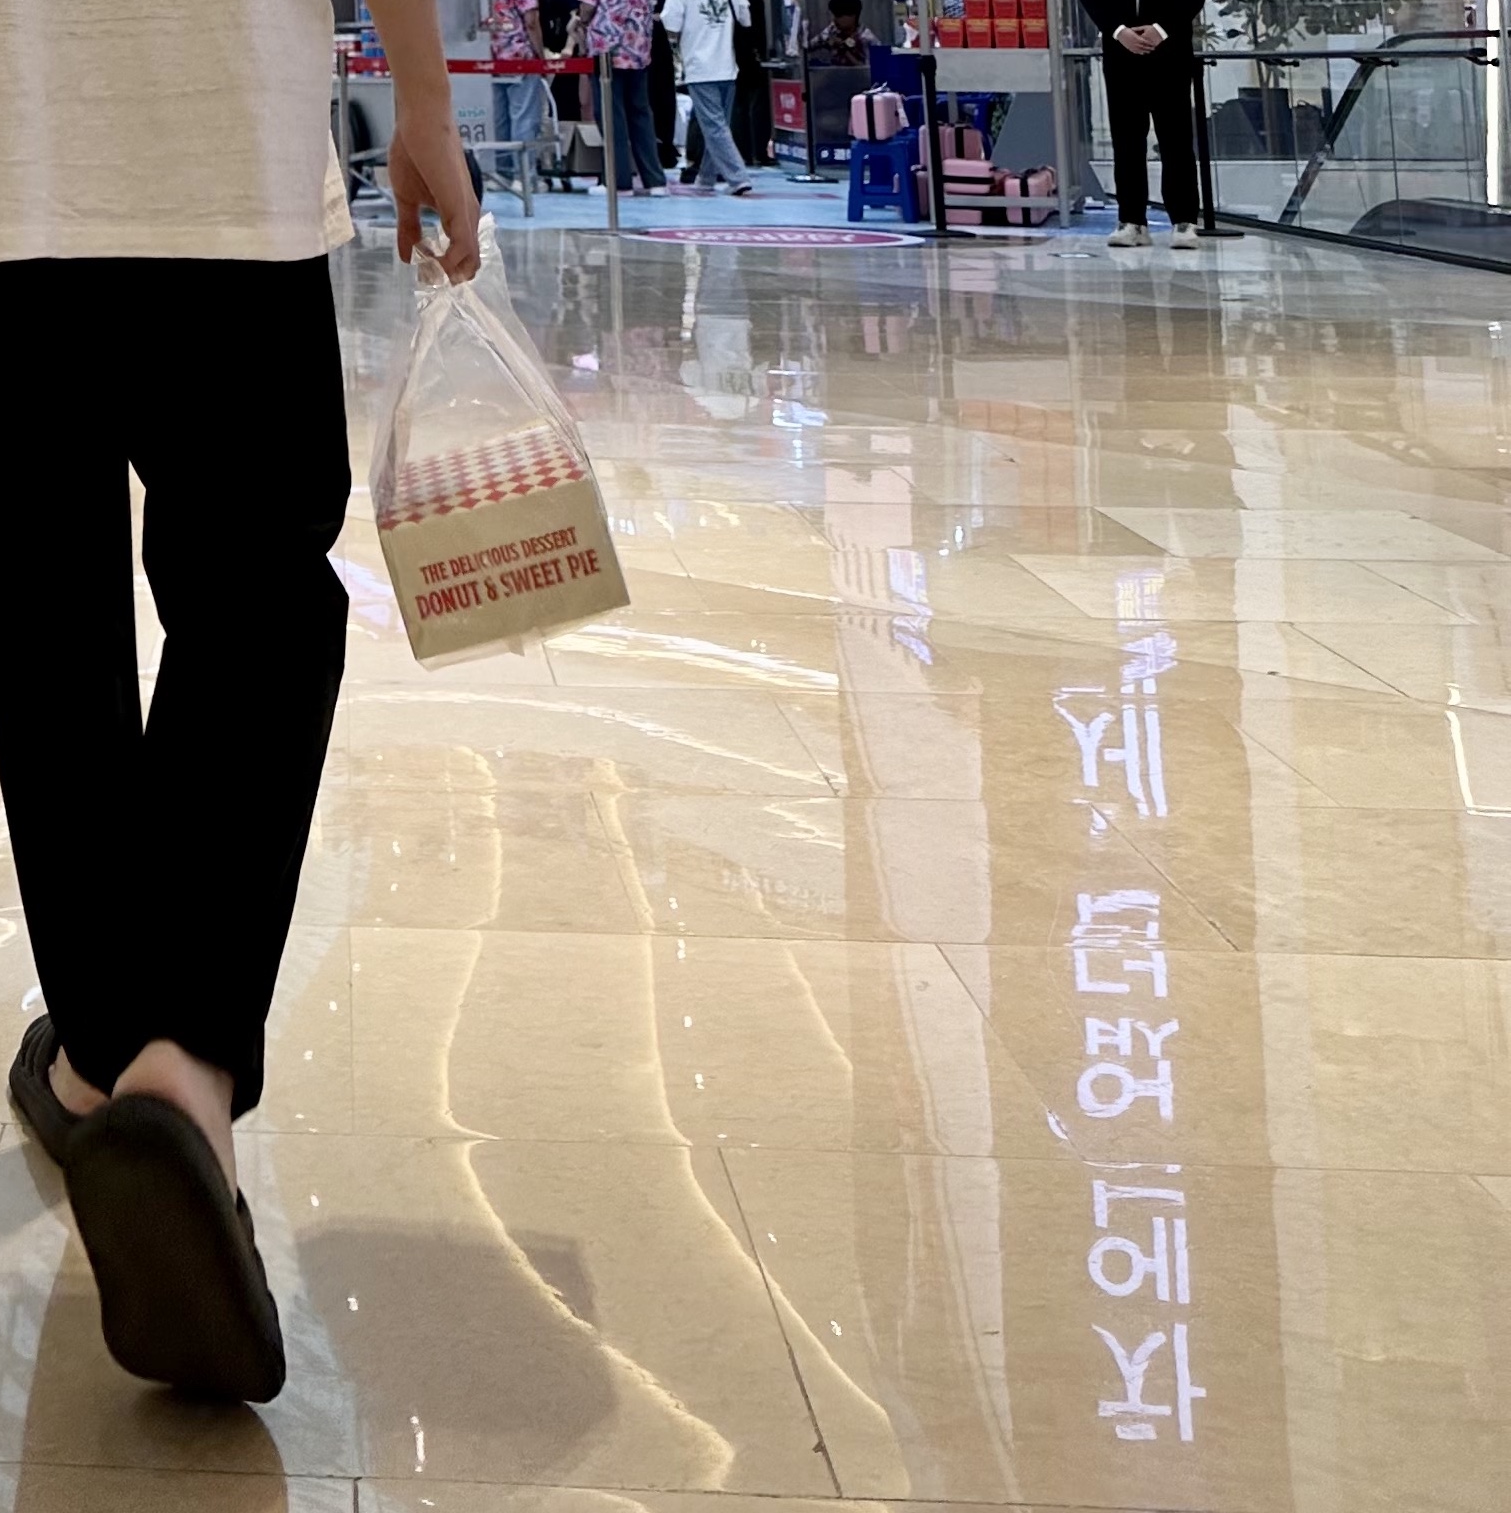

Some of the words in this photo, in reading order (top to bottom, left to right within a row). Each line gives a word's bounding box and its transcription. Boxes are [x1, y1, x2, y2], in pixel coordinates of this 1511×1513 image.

[415, 580, 483, 621] DONUT
[484, 578, 500, 602] &
[499, 557, 565, 599] SWEET
[566, 548, 601, 580] PIE
[419, 561, 448, 586] THE
[449, 543, 520, 577] DELICIOUS
[520, 526, 579, 558] DESSERT
